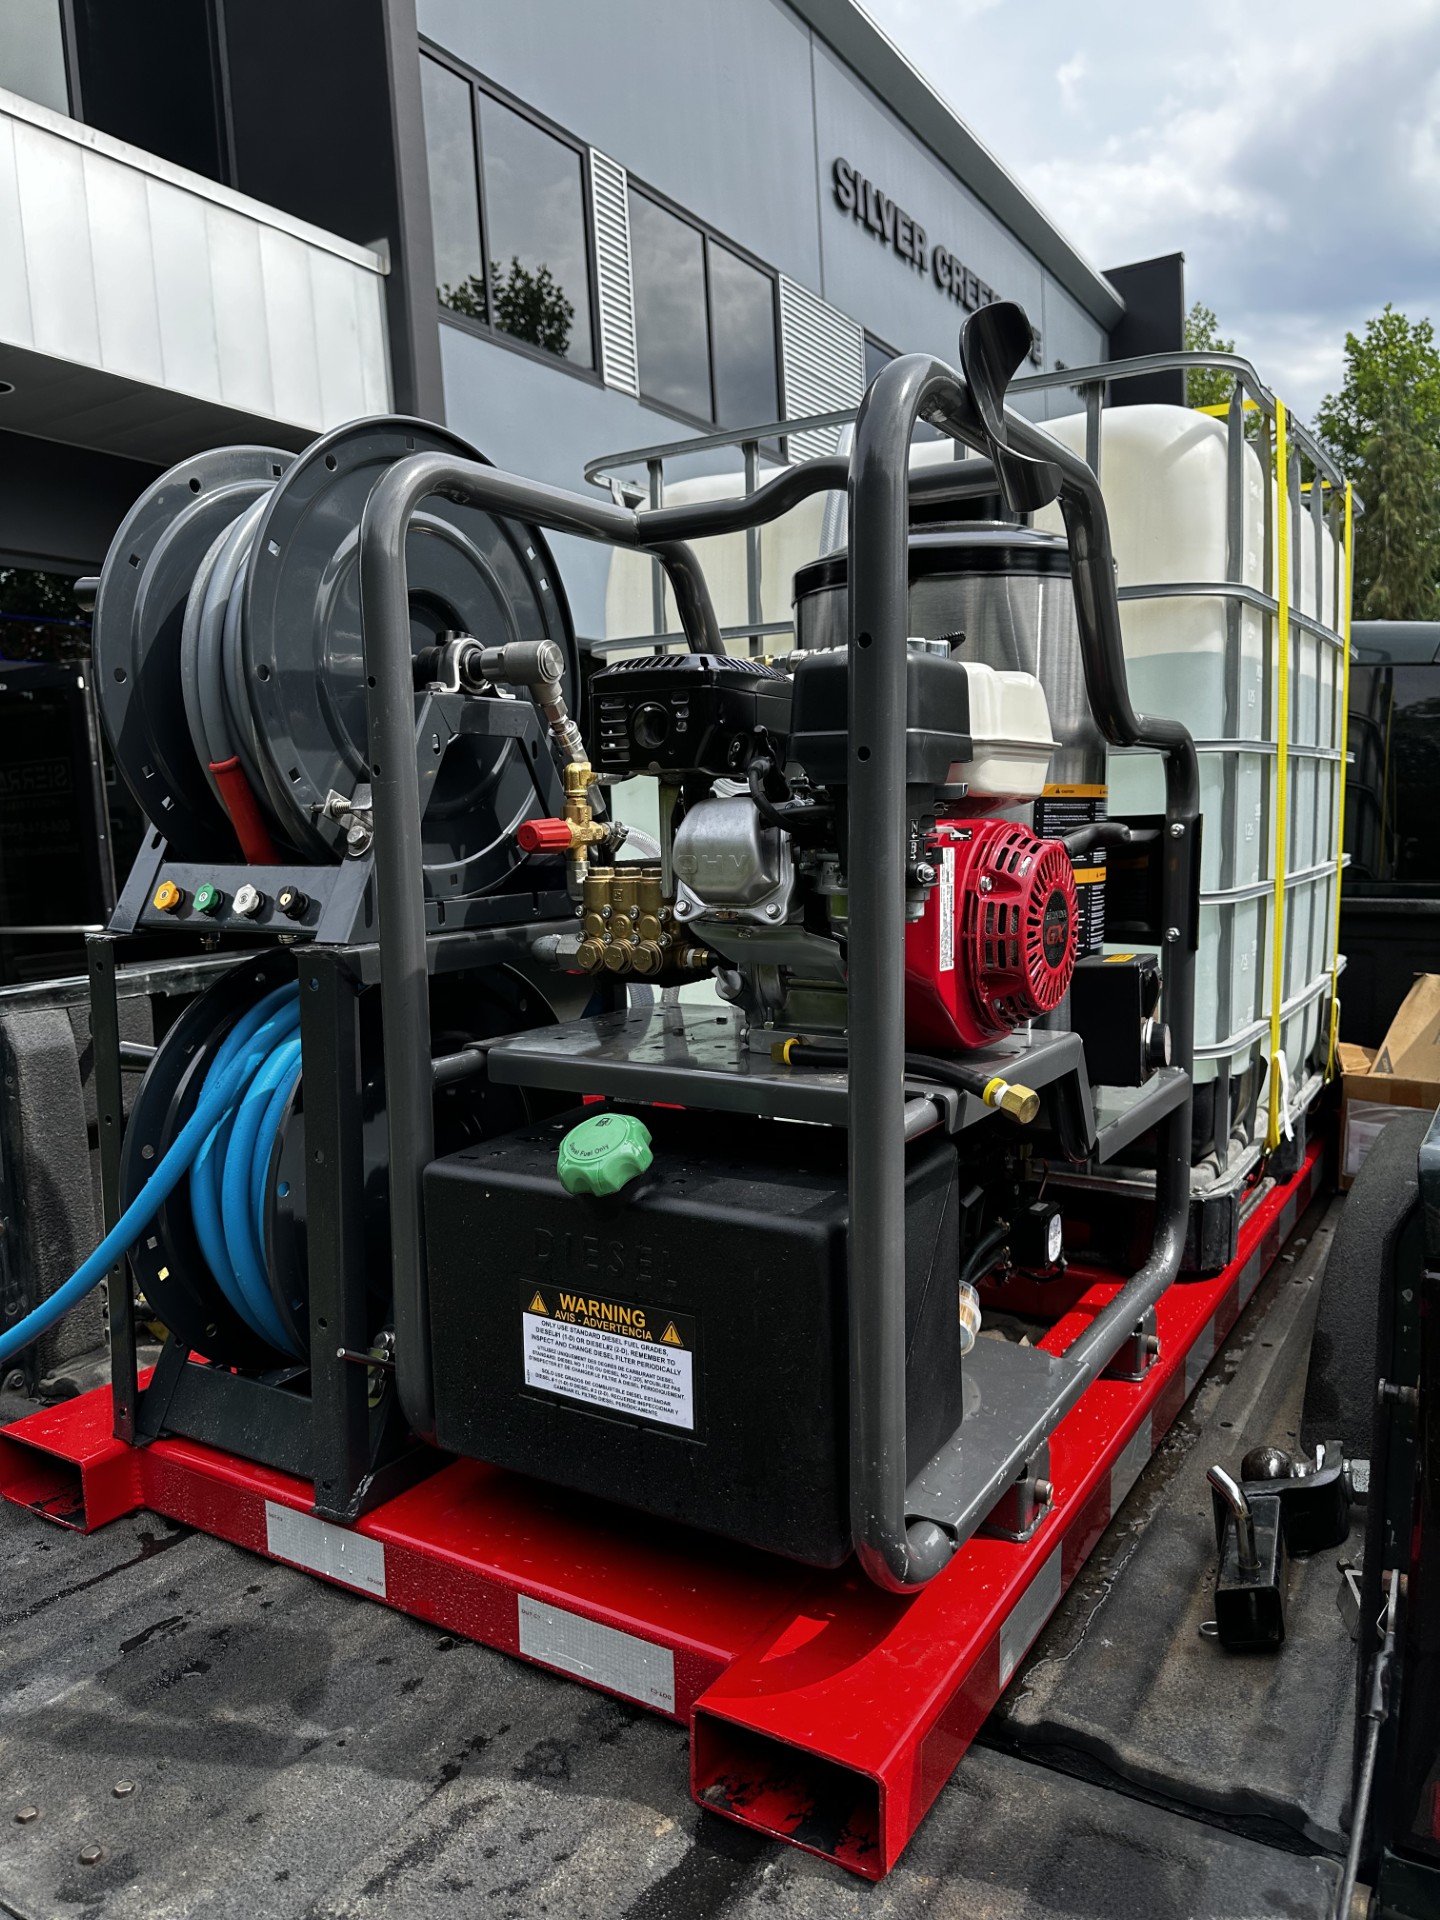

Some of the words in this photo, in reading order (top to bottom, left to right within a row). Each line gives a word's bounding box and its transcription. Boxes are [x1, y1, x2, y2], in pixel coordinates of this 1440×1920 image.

[832, 157, 928, 273] SILVER
[933, 245, 1001, 313] CREE
[676, 854, 747, 874] OHV
[1046, 924, 1066, 945] GX
[559, 1293, 646, 1328] WARNING
[542, 1320, 555, 1329] ONLY
[557, 1323, 568, 1332] USE
[570, 1326, 600, 1340] STANDARD
[602, 1334, 623, 1345] DIESEL
[625, 1340, 639, 1349] FUEL
[554, 1312, 576, 1324] AVIS
[583, 1318, 653, 1341] ADVERTENCIA
[531, 1333, 554, 1345] INSPECT
[555, 1339, 567, 1348] AND
[569, 1342, 592, 1355] CHANGE
[594, 1349, 613, 1360] DIESEL
[616, 1354, 636, 1366] FILTER
[637, 1359, 682, 1377] PERIODICALLY
[576, 1336, 585, 1345] OR
[631, 1350, 665, 1364] REMEMBER
[667, 1358, 676, 1367] TO
